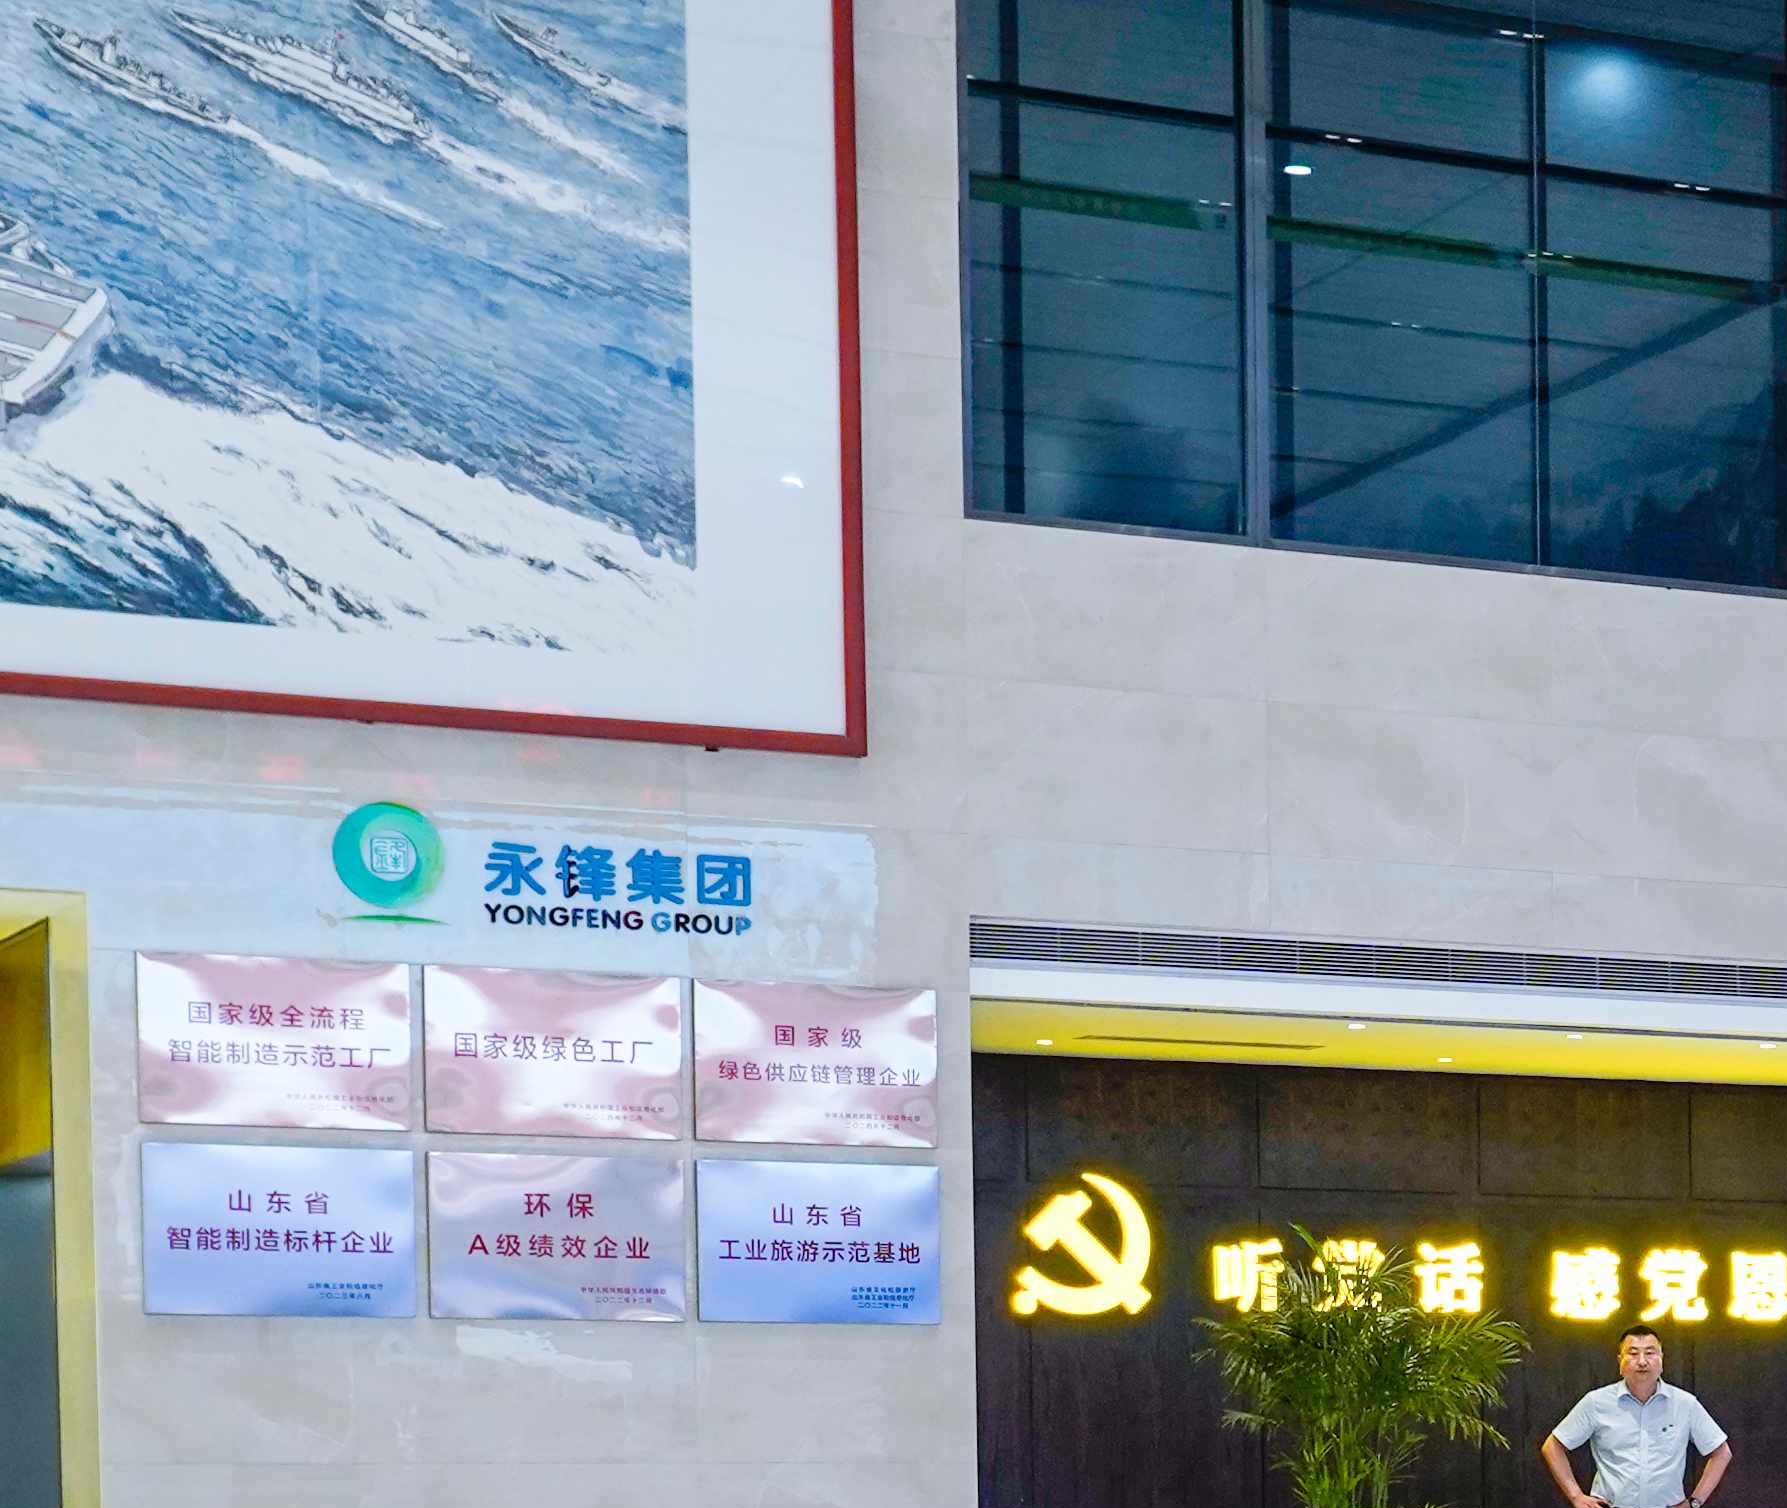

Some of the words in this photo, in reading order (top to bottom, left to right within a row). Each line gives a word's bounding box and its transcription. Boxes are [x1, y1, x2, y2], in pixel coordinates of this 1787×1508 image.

[484, 841, 752, 907] 永锋集团
[484, 903, 644, 931] YONGFENG
[651, 911, 752, 936] GROUP
[188, 1001, 365, 1030] 国家级全流程
[454, 1032, 653, 1064] 国家级绿色工厂
[774, 1025, 862, 1048] 国家级
[168, 1038, 391, 1069] 智能制造示范工厂
[719, 1060, 921, 1087] 绿色供应链管理企业
[229, 1189, 329, 1215] 山东省
[524, 1193, 594, 1218] 环保
[773, 1203, 862, 1227] 山东省
[167, 1226, 394, 1254] 智能制造标杆企业
[468, 1233, 650, 1260] A级绩效企业
[719, 1239, 921, 1265] 工业旅游示范基地
[1211, 1237, 1485, 1314] 听党话
